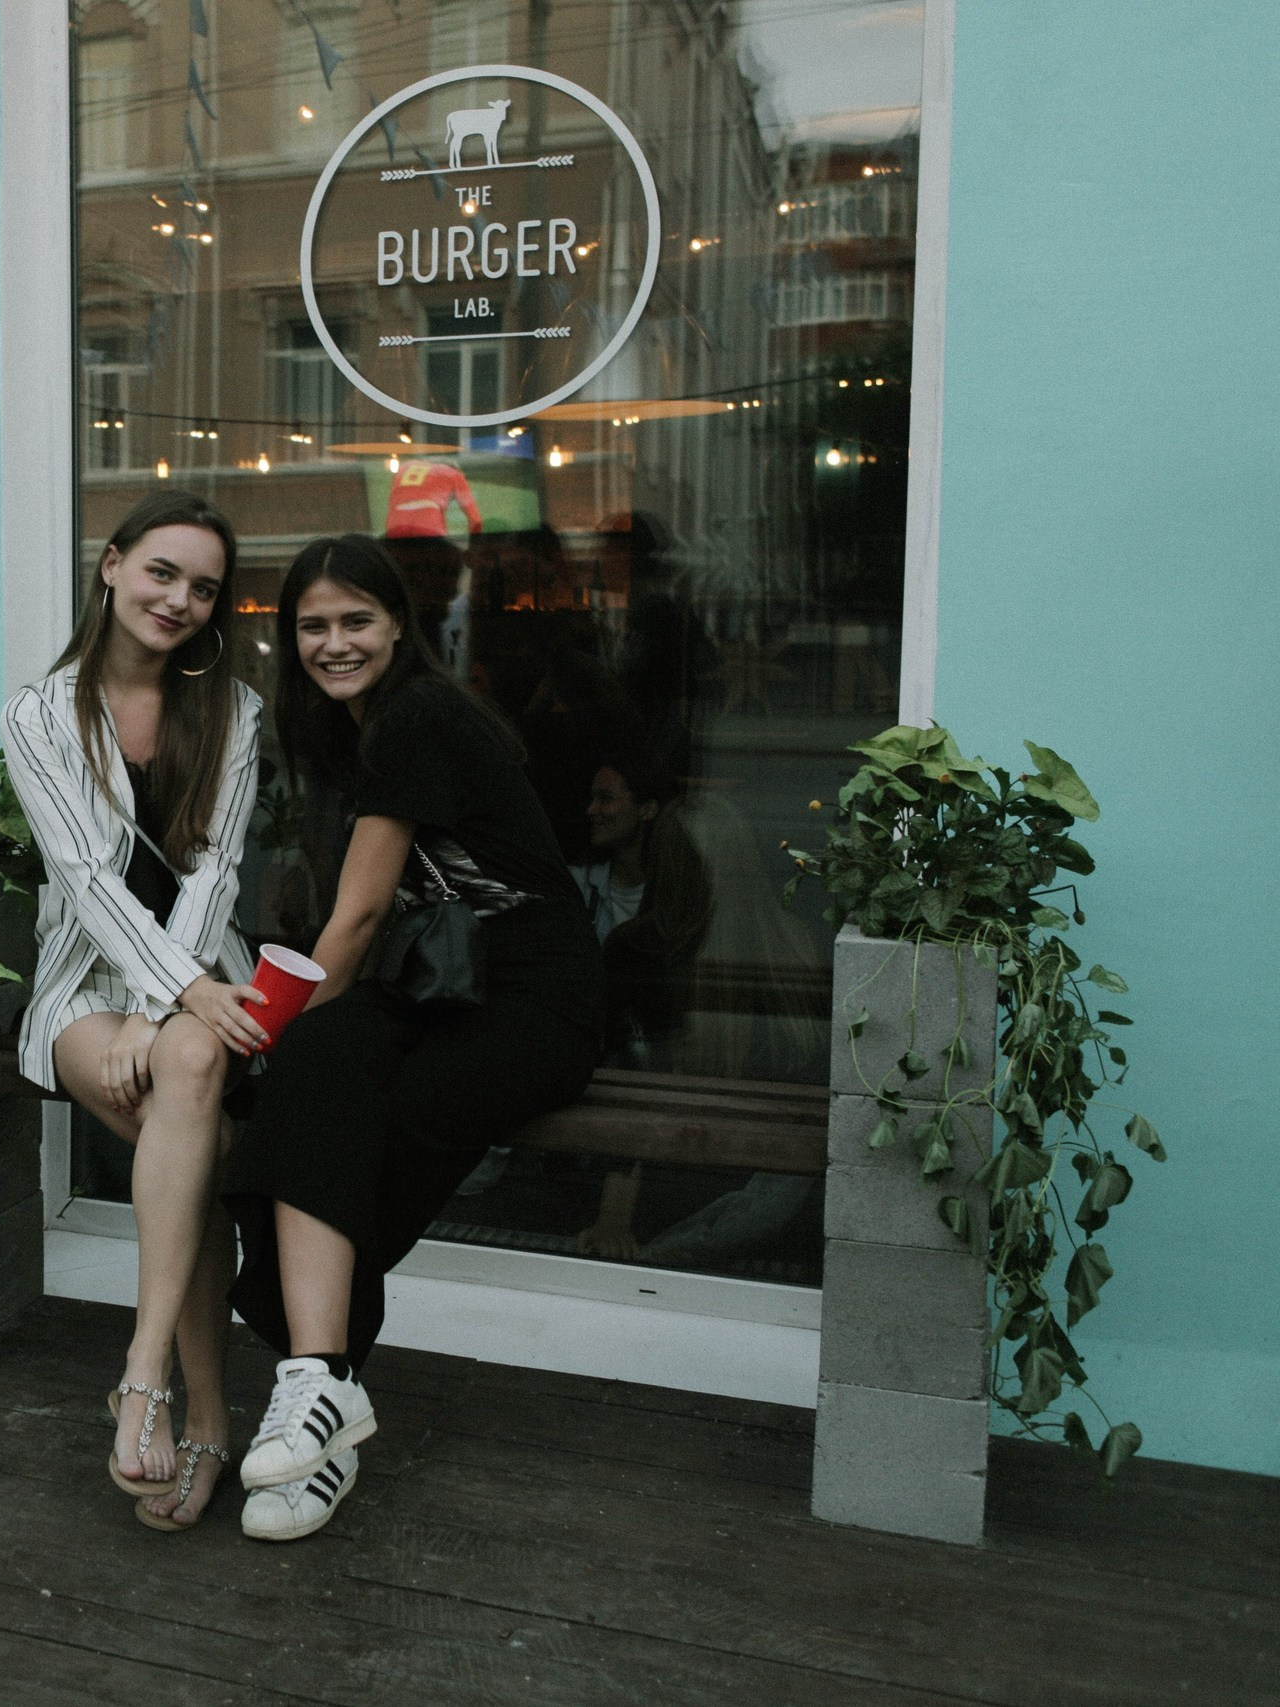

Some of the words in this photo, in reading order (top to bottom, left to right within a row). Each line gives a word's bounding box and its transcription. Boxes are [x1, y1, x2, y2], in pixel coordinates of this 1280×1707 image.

[455, 186, 492, 207] THE
[378, 218, 577, 286] BURGER
[454, 297, 495, 318] LAB.
